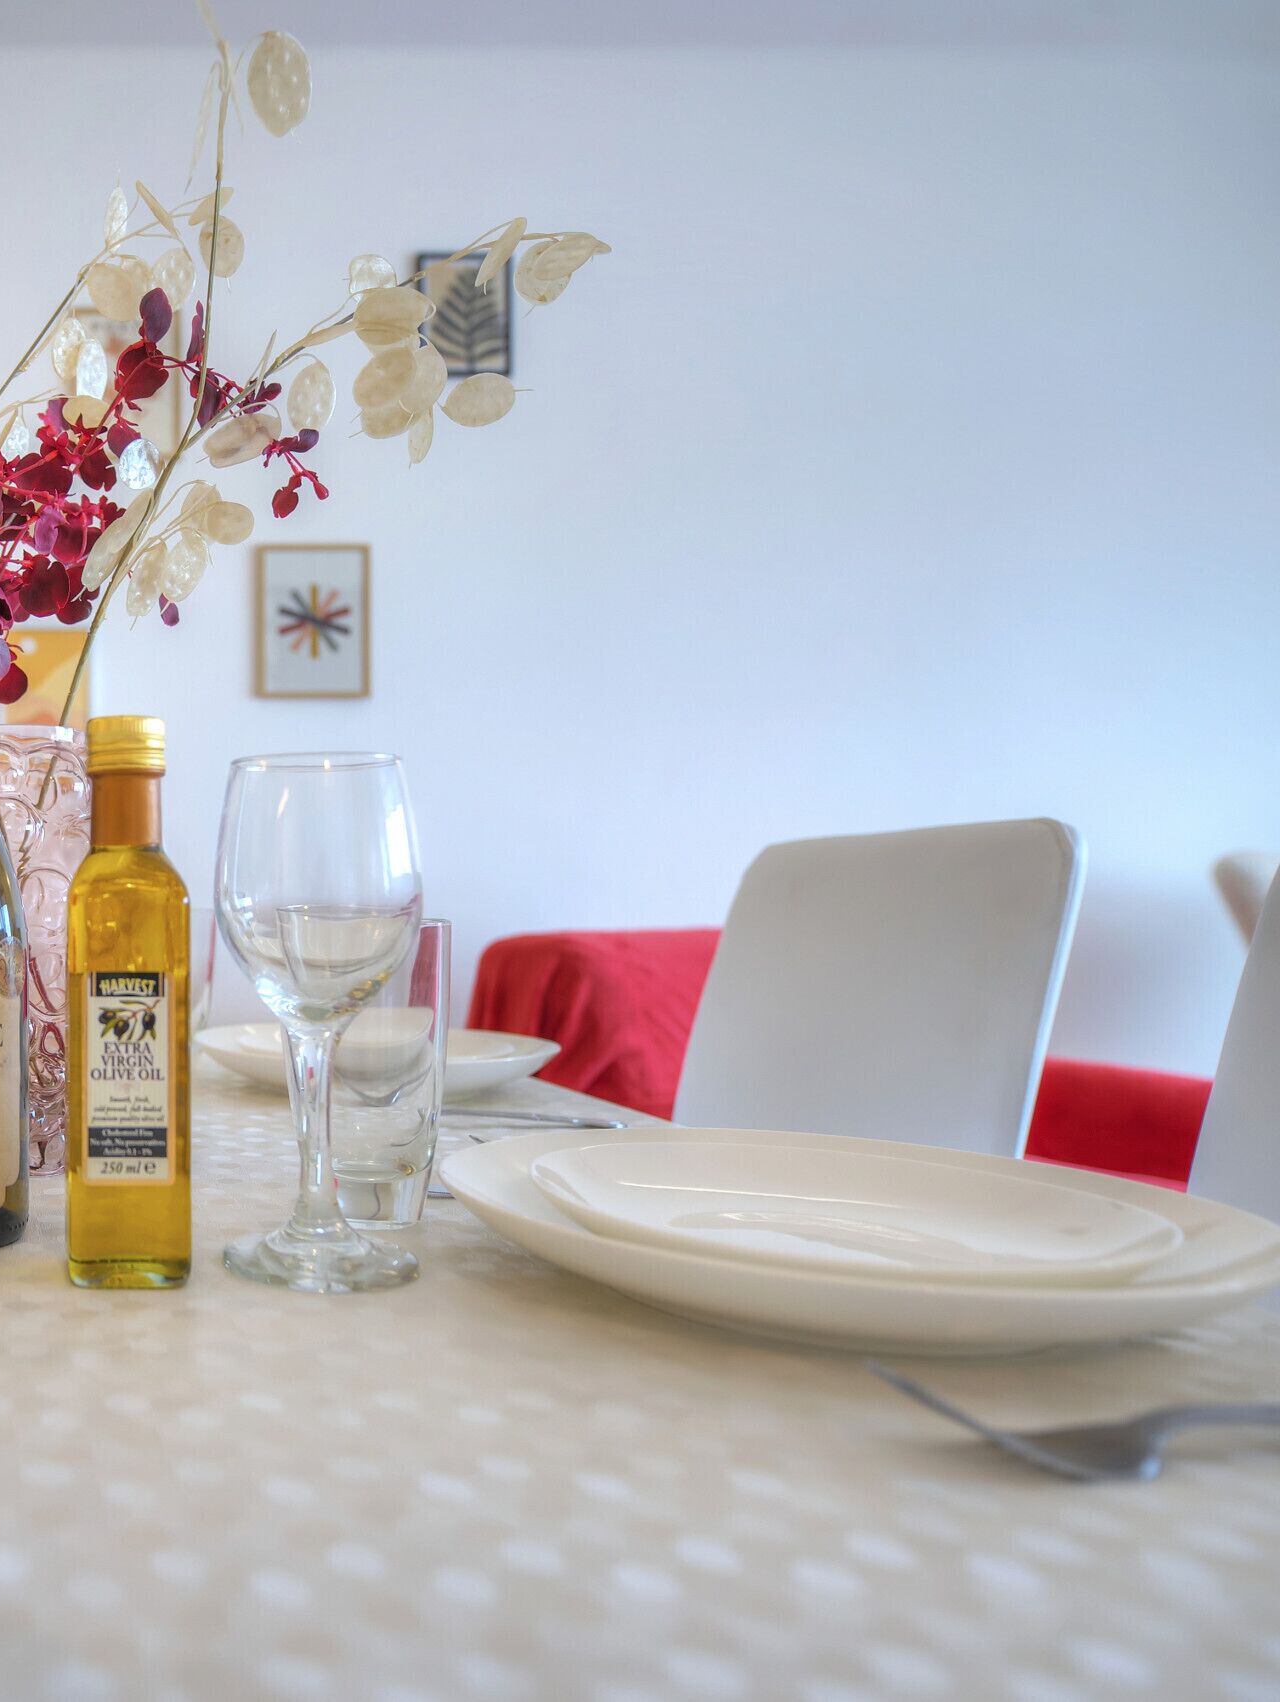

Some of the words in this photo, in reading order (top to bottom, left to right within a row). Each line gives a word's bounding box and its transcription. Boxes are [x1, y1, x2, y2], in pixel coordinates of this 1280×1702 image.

[99, 977, 156, 996] HARVEST
[103, 1042, 151, 1054] EXTRA
[101, 1055, 154, 1067] VIRGIN
[90, 1068, 136, 1081] OLIVE
[138, 1069, 165, 1081] OIL
[101, 1162, 123, 1174] 250
[125, 1161, 142, 1174] ml
